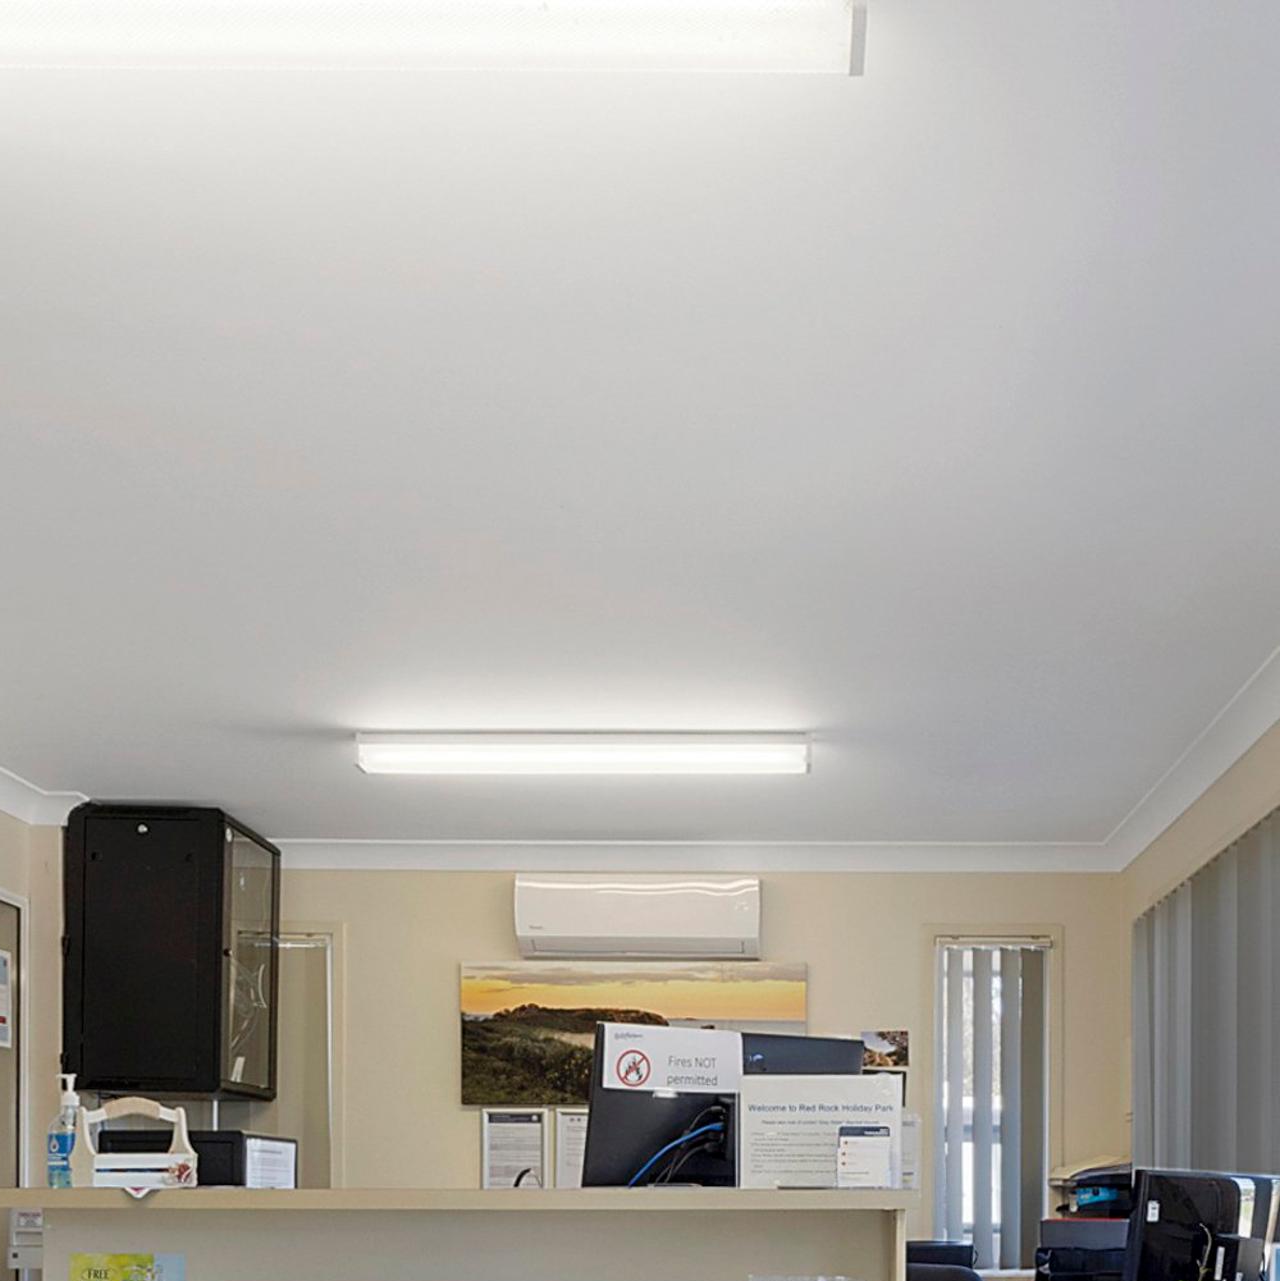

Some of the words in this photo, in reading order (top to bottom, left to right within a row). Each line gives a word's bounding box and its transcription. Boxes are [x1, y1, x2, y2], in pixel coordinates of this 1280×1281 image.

[668, 1056, 692, 1067] Fires
[694, 1057, 717, 1068] NOT
[666, 1075, 718, 1086] permitted
[748, 1103, 786, 1112] Welcome
[788, 1104, 796, 1112] to
[799, 1103, 816, 1112] Red
[819, 1103, 838, 1112] Rock
[841, 1103, 872, 1113] Holiday
[875, 1103, 894, 1112] Park
